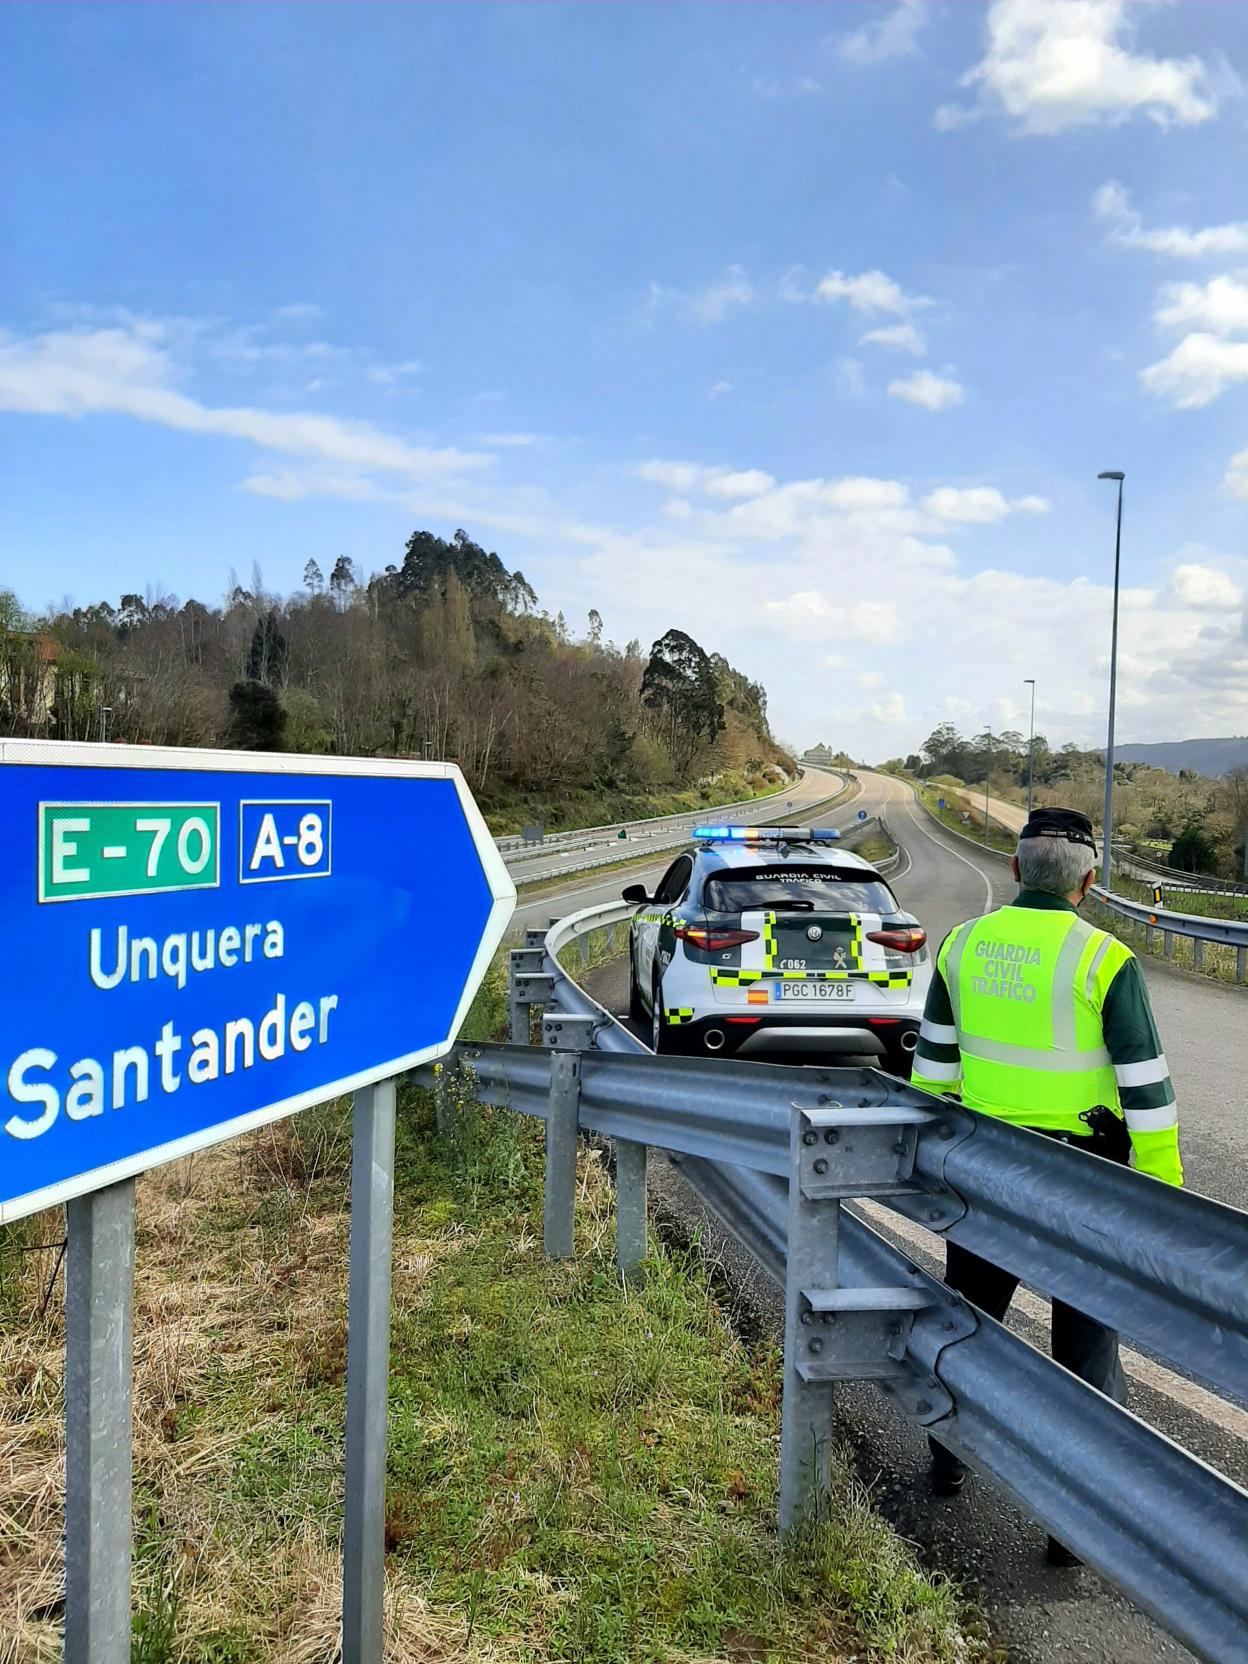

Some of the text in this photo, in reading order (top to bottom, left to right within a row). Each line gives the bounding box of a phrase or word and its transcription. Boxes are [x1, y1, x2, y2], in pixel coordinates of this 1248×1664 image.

[52, 816, 212, 884] E-70
[249, 812, 324, 870] A-8
[812, 873, 842, 881] CIVIL
[89, 920, 285, 991] Unquera
[787, 959, 807, 969] 062
[975, 940, 1041, 965] GUARDIA
[983, 959, 1024, 982] CIVIL
[783, 983, 854, 997] PGC 1678F
[970, 976, 1037, 1003] TRAFICO
[4, 993, 339, 1140] Santander
